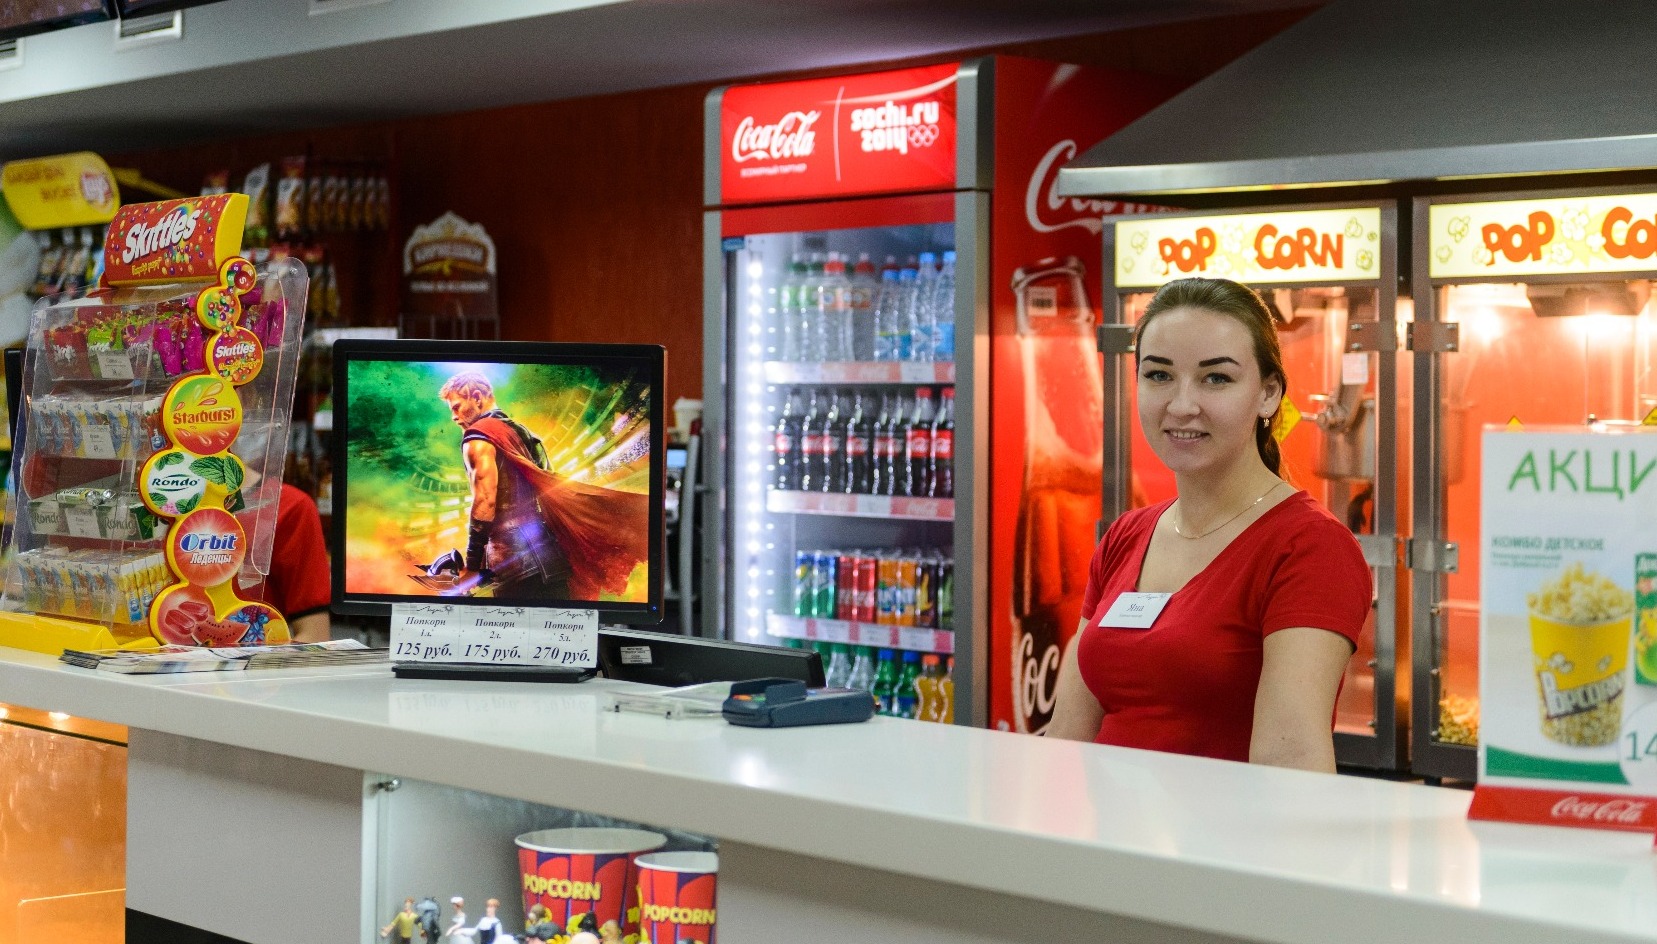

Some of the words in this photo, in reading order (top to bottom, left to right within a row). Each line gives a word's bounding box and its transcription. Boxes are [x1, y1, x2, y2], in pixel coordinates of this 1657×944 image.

[851, 101, 939, 131] sochi.ru
[861, 127, 908, 154] 2014
[122, 209, 201, 263] Skittles
[1481, 210, 1555, 266] POP
[1602, 206, 1657, 260] CO
[1158, 227, 1217, 275] POP
[1254, 224, 1344, 270] CORN
[215, 343, 256, 358] Skittles
[173, 408, 235, 424] Starburst
[152, 477, 198, 487] Rondo
[180, 533, 238, 552] Orbit
[190, 553, 232, 565] Леденцы
[406, 616, 446, 628] Попкорн
[475, 618, 515, 629] Попкорн
[544, 621, 584, 632] Попкорн
[396, 642, 421, 656] 125
[422, 643, 452, 660] руб.
[464, 644, 490, 658] 175
[491, 645, 521, 662] руб.
[532, 646, 560, 660] 270
[561, 649, 591, 665] руб.
[524, 873, 601, 900] POPCORN
[643, 902, 717, 925] POPCORN
